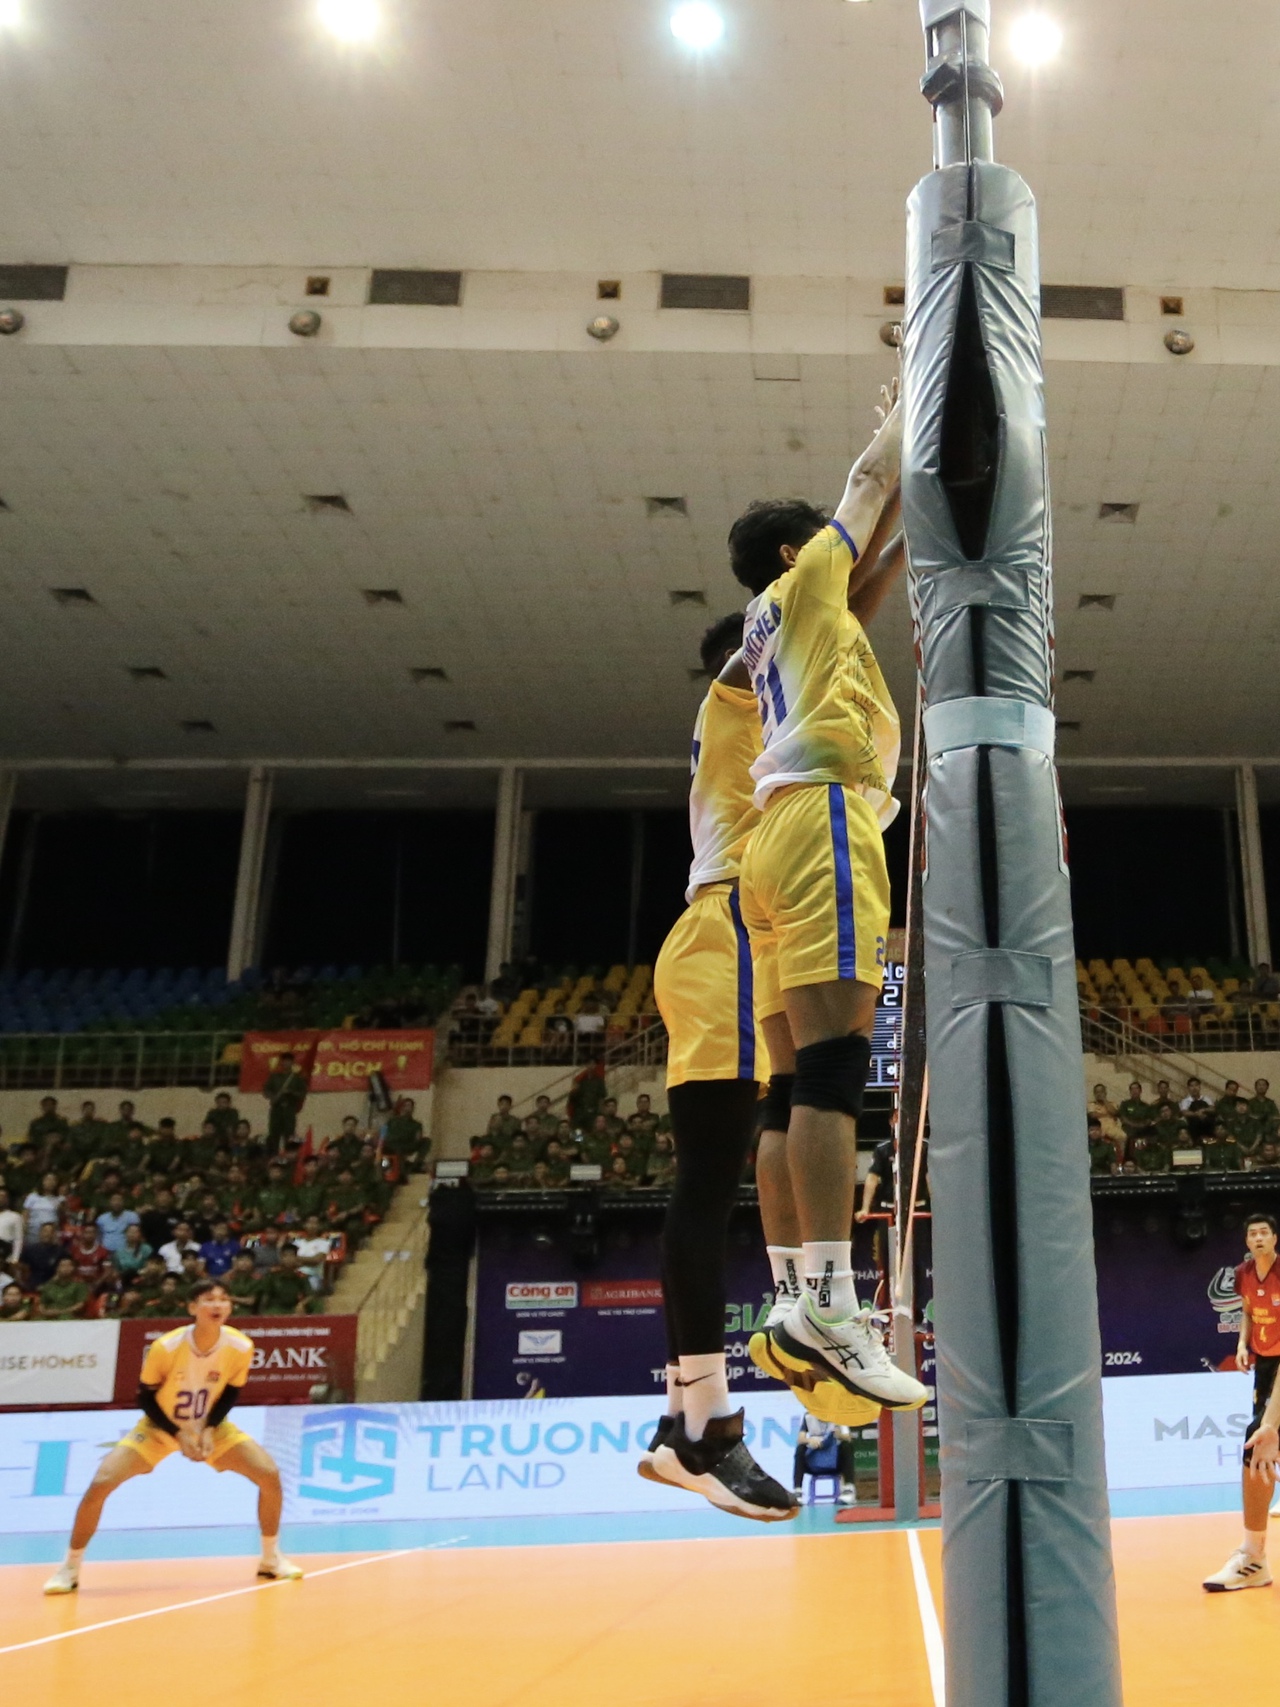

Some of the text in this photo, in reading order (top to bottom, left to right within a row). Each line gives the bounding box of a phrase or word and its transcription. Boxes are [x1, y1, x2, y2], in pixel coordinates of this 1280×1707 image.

[508, 1285, 575, 1300] Công an
[604, 1288, 663, 1300] AGRIBANK
[1259, 1326, 1267, 1343] 4
[31, 1353, 98, 1369] HOMES
[249, 1347, 328, 1369] BANK
[1105, 1352, 1143, 1366] 2024
[174, 1388, 210, 1421] 20
[427, 1461, 566, 1492] LAND
